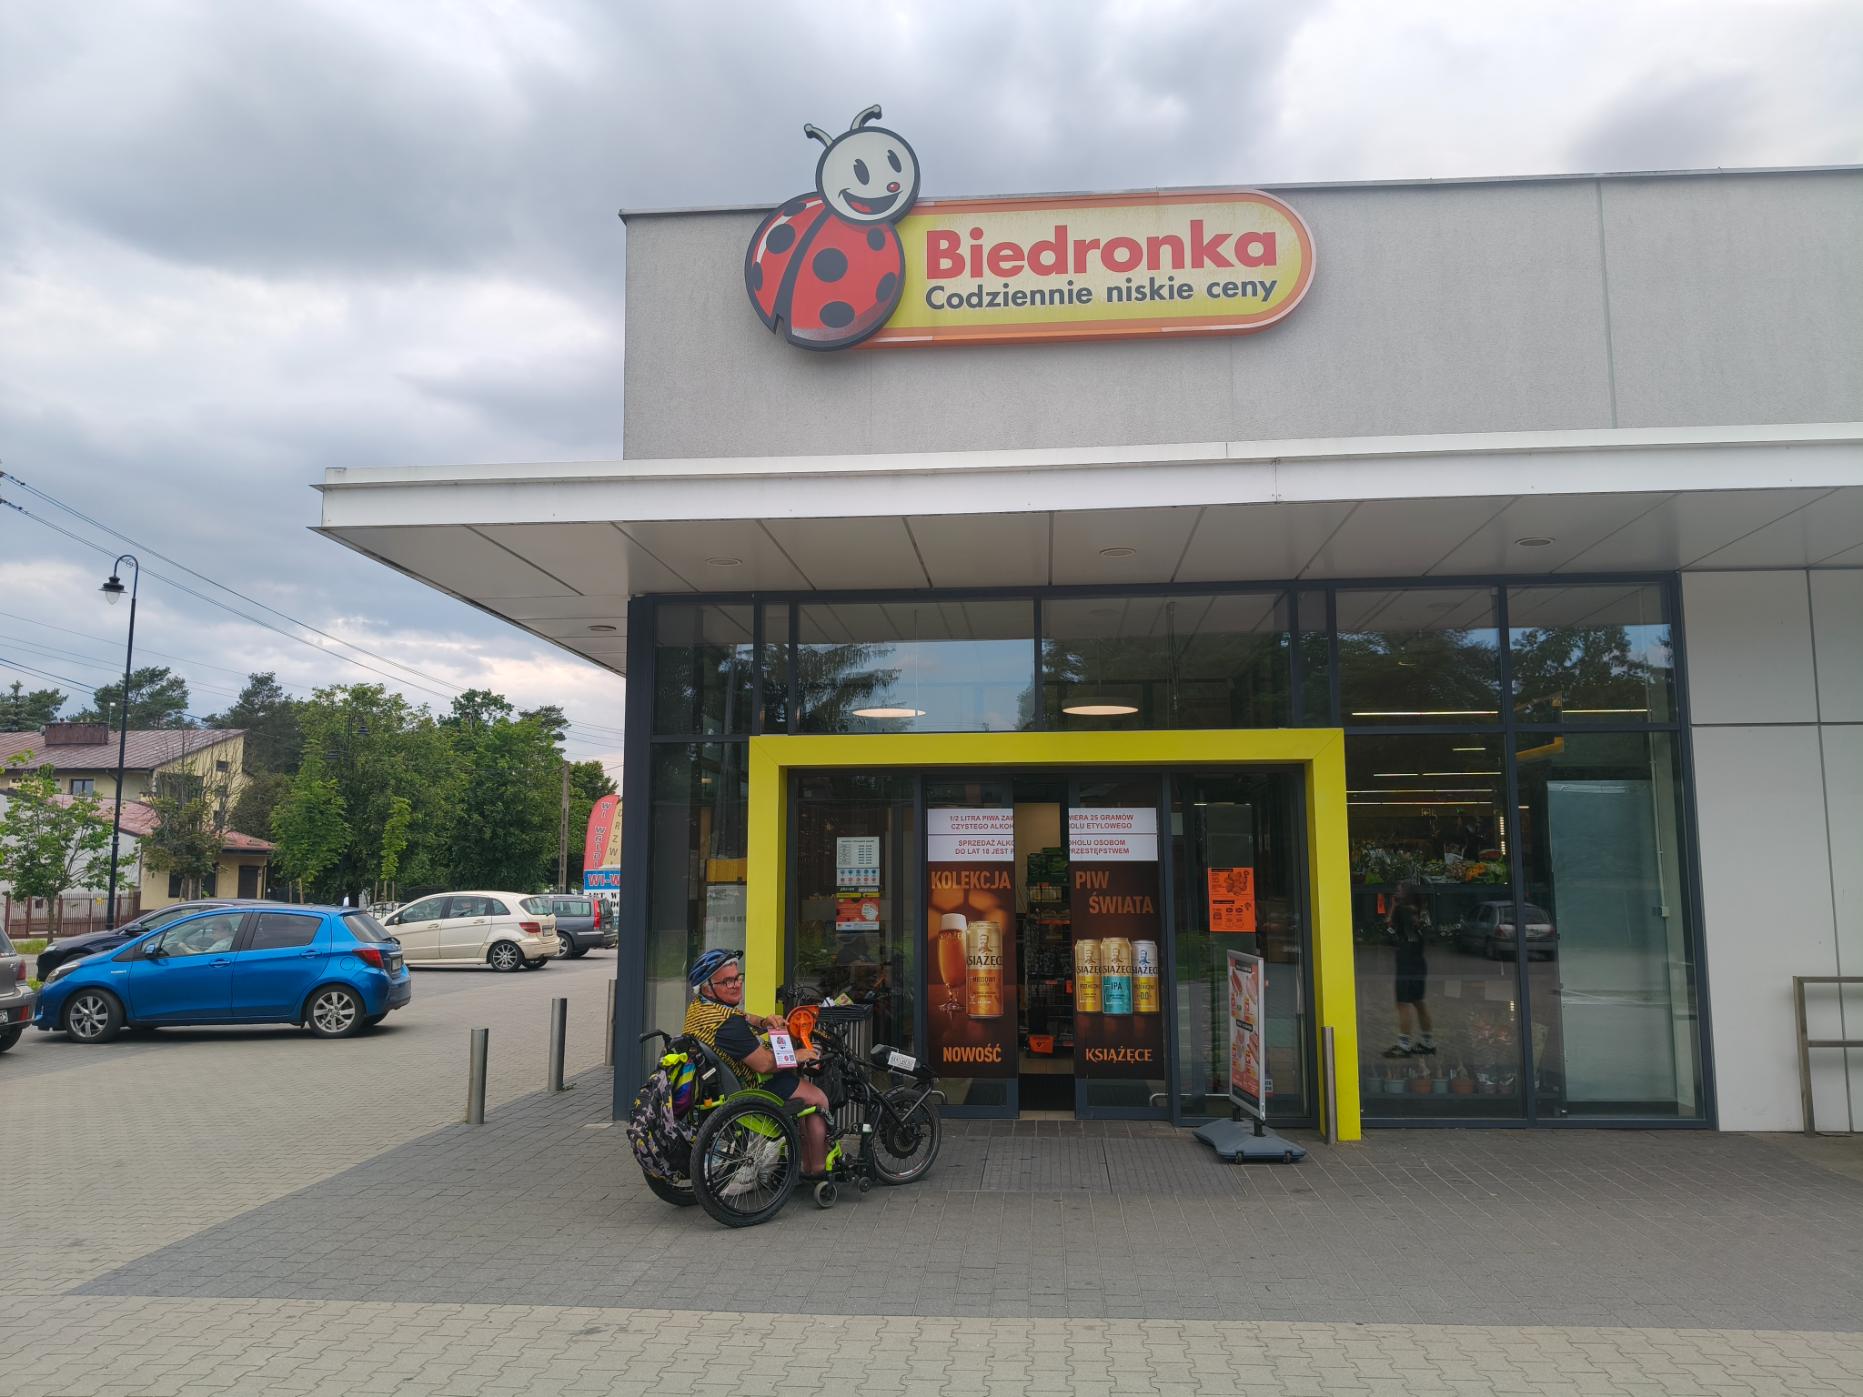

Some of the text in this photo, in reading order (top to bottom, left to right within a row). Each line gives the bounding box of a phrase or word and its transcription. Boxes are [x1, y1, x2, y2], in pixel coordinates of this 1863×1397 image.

[926, 219, 1277, 279] Biedronka
[926, 275, 1278, 309] Codziennie niskie ceny
[931, 870, 1012, 889] KOLEKCJA
[1075, 870, 1110, 889] PIW
[1088, 891, 1154, 914] ŚWIATA
[1111, 981, 1123, 991] IPA
[943, 1044, 1002, 1062] NOWOŚĆ
[1085, 1045, 1153, 1063] KSIĄŻĘCE
